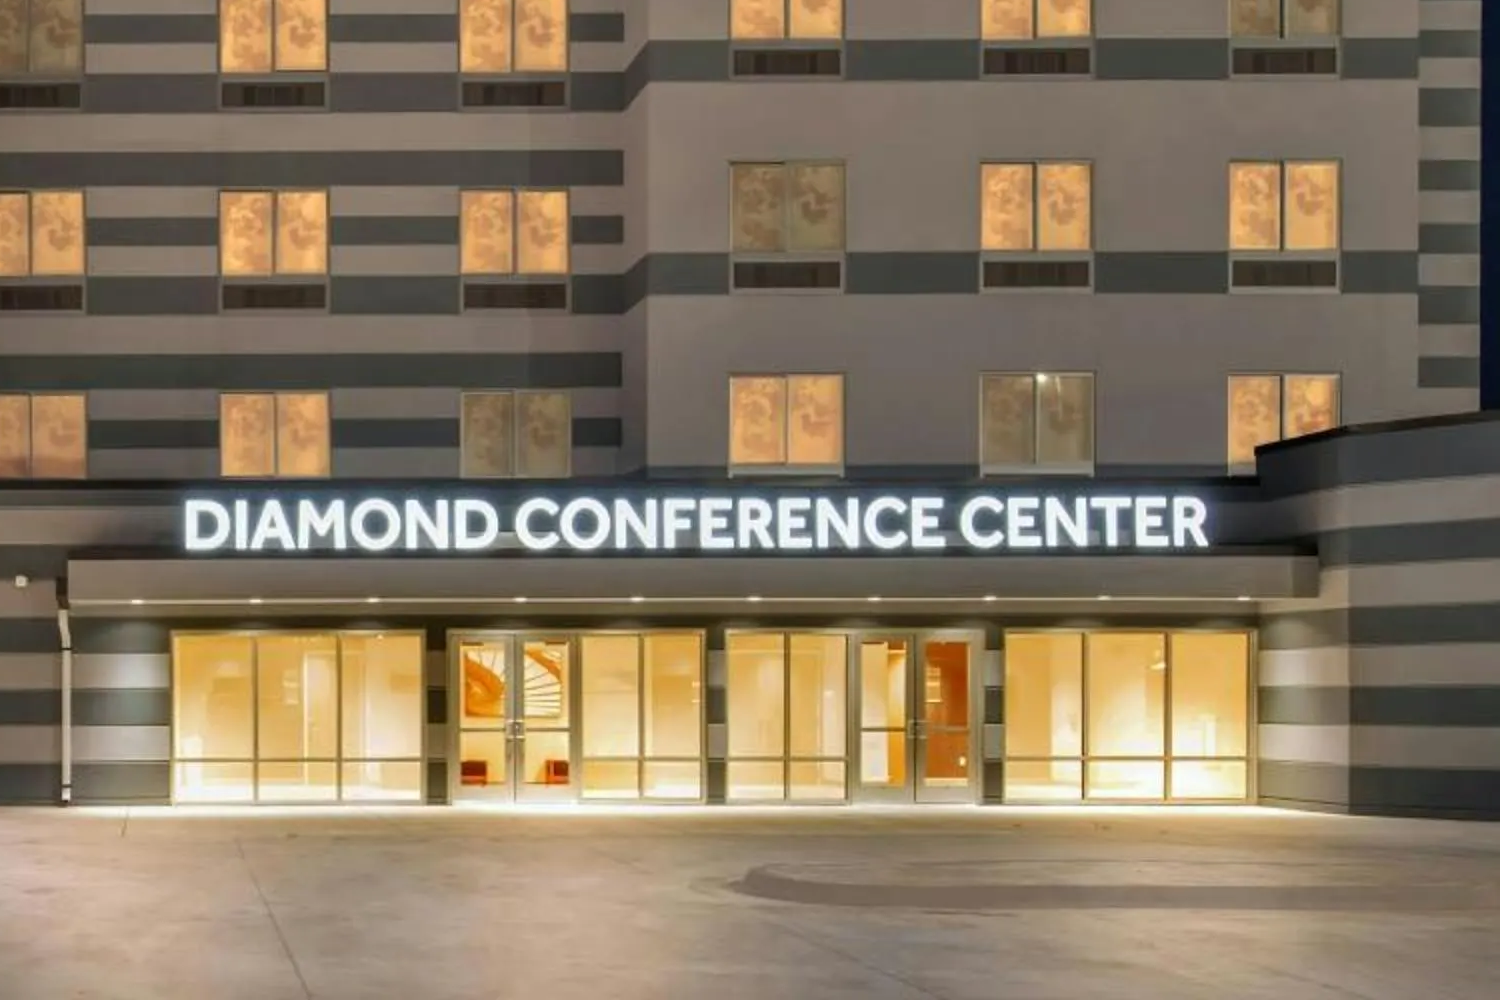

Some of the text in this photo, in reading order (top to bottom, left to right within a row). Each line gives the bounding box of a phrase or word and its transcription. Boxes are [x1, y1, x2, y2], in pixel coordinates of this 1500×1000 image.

[184, 495, 1209, 551] DIAMOND CONFERENCE CENTER
